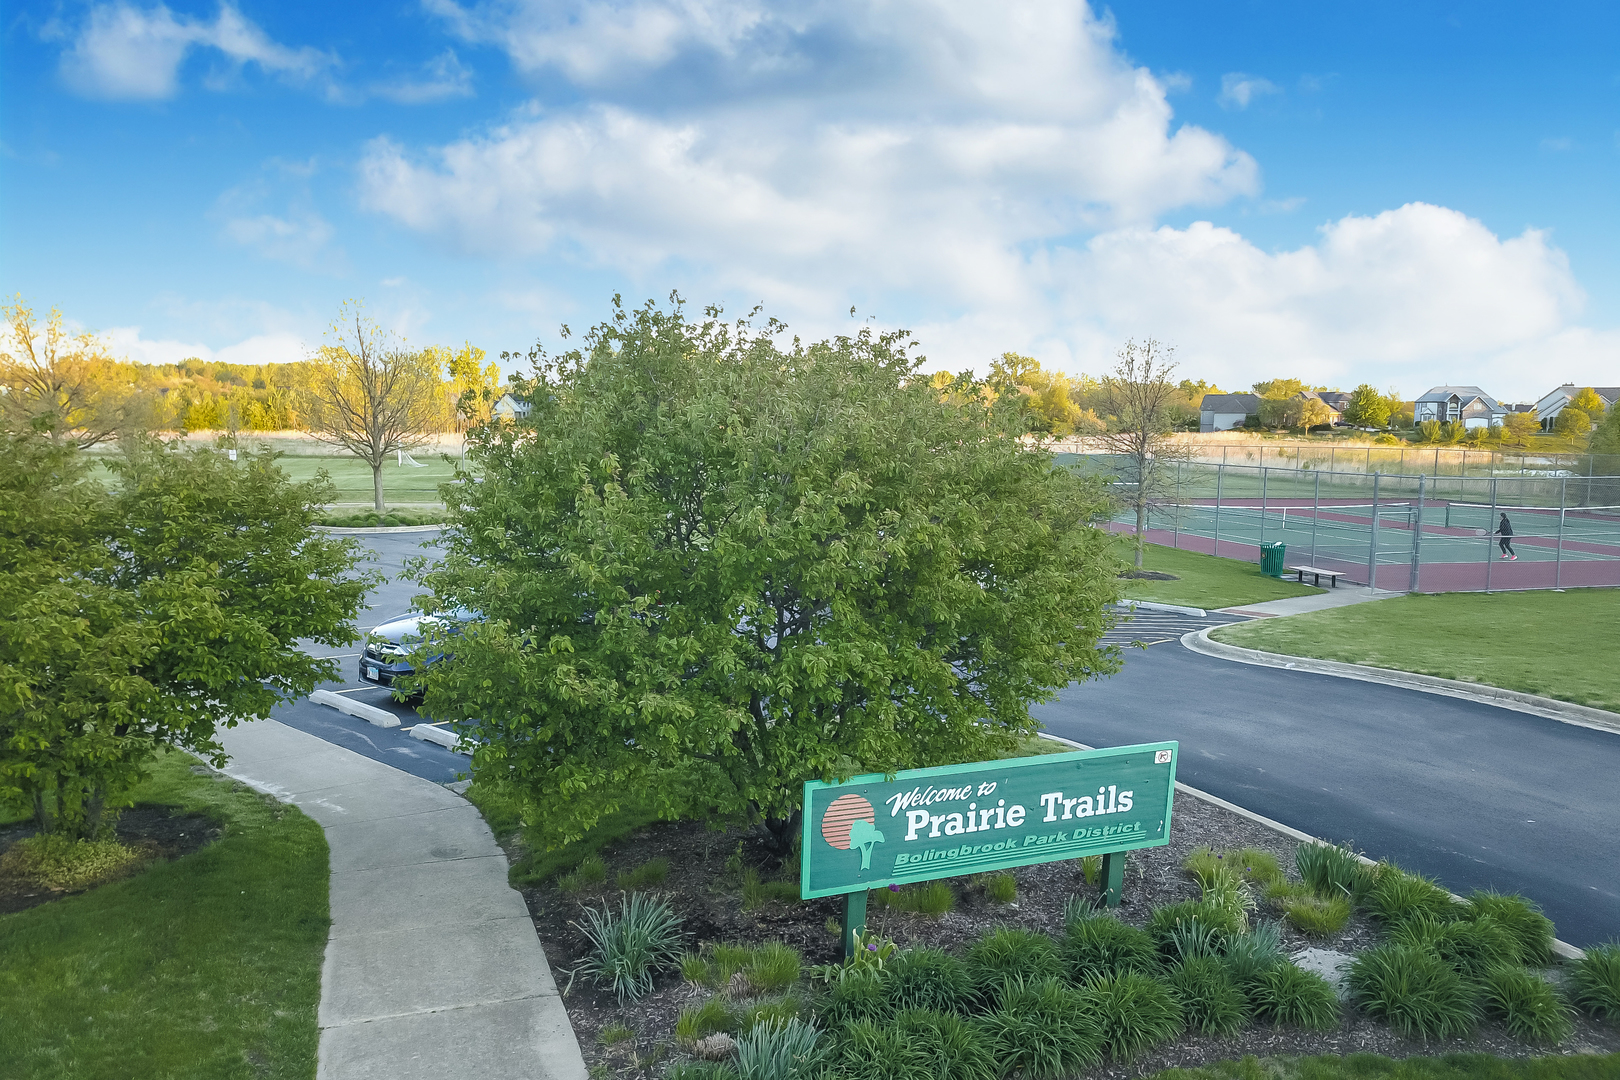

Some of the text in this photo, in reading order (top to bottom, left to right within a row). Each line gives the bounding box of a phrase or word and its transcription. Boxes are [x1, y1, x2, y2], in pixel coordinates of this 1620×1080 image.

[886, 781, 997, 817] Welcome to
[905, 785, 1133, 841] Prairie Trails
[895, 821, 1141, 865] Bolingbrook Park District
